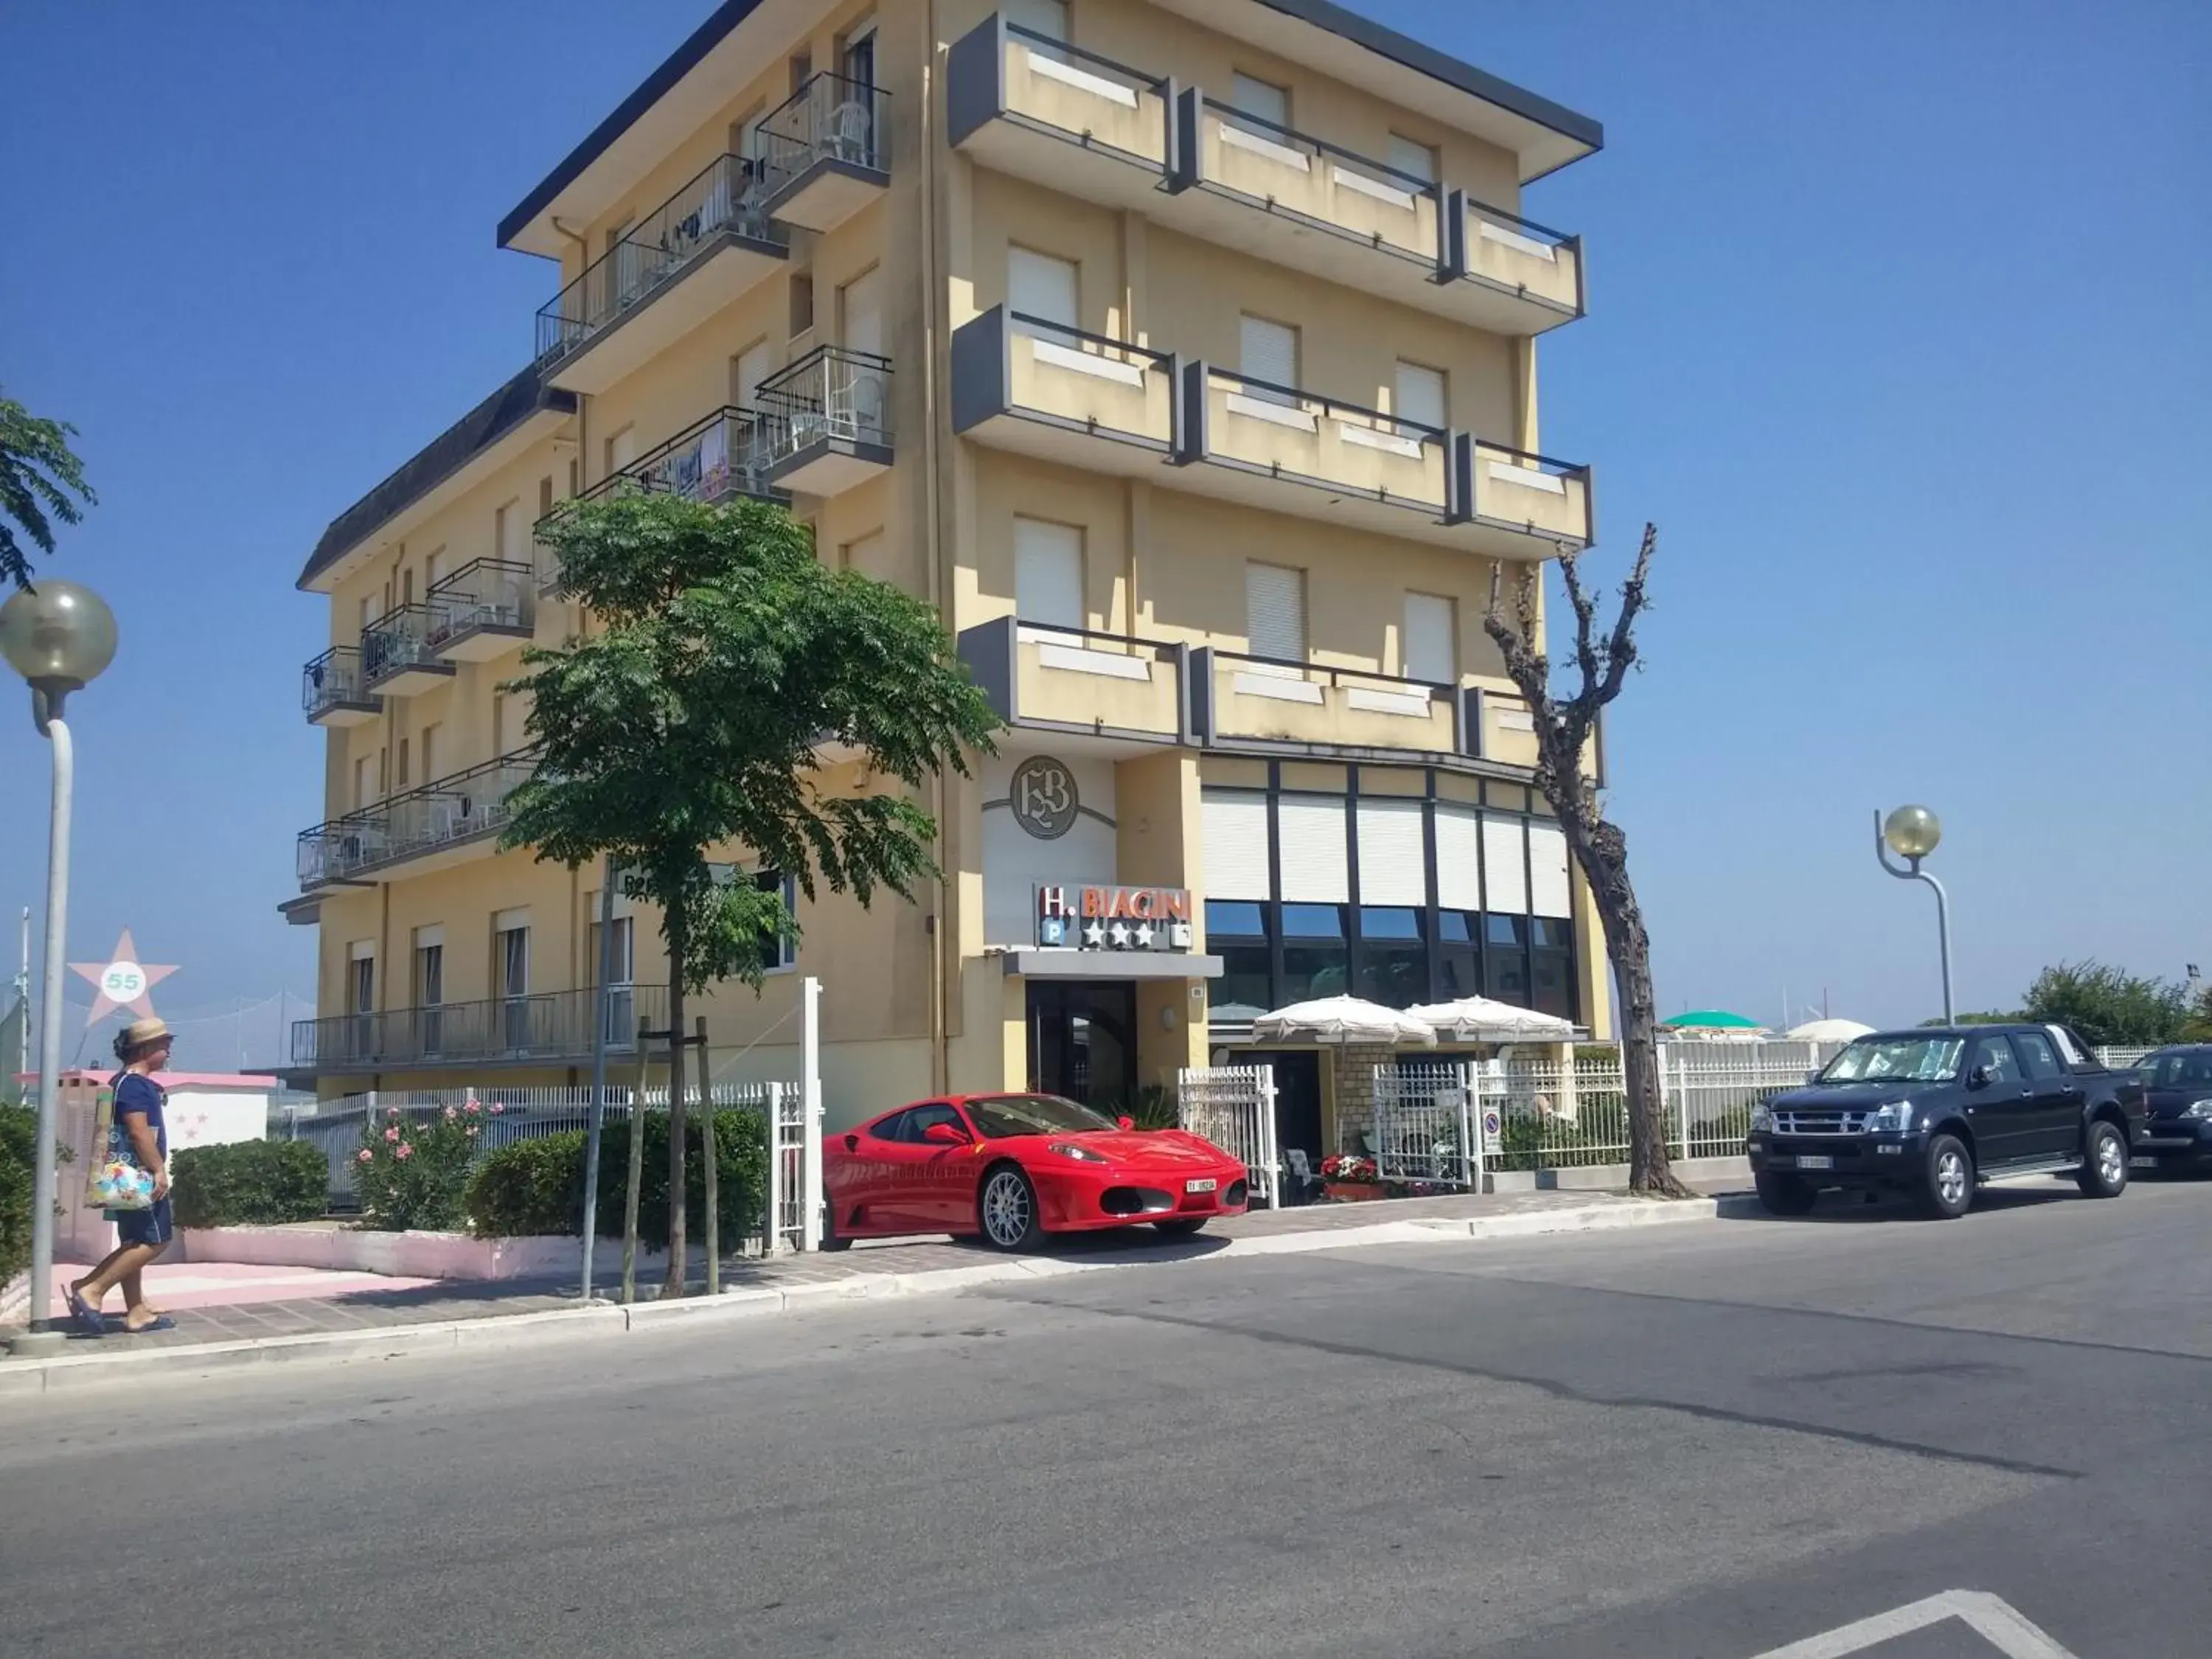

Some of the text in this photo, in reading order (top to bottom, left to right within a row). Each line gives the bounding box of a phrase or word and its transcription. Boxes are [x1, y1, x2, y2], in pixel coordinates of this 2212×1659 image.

[1040, 886, 1077, 917] H.
[1048, 923, 1062, 941] P
[105, 973, 139, 990] 55
